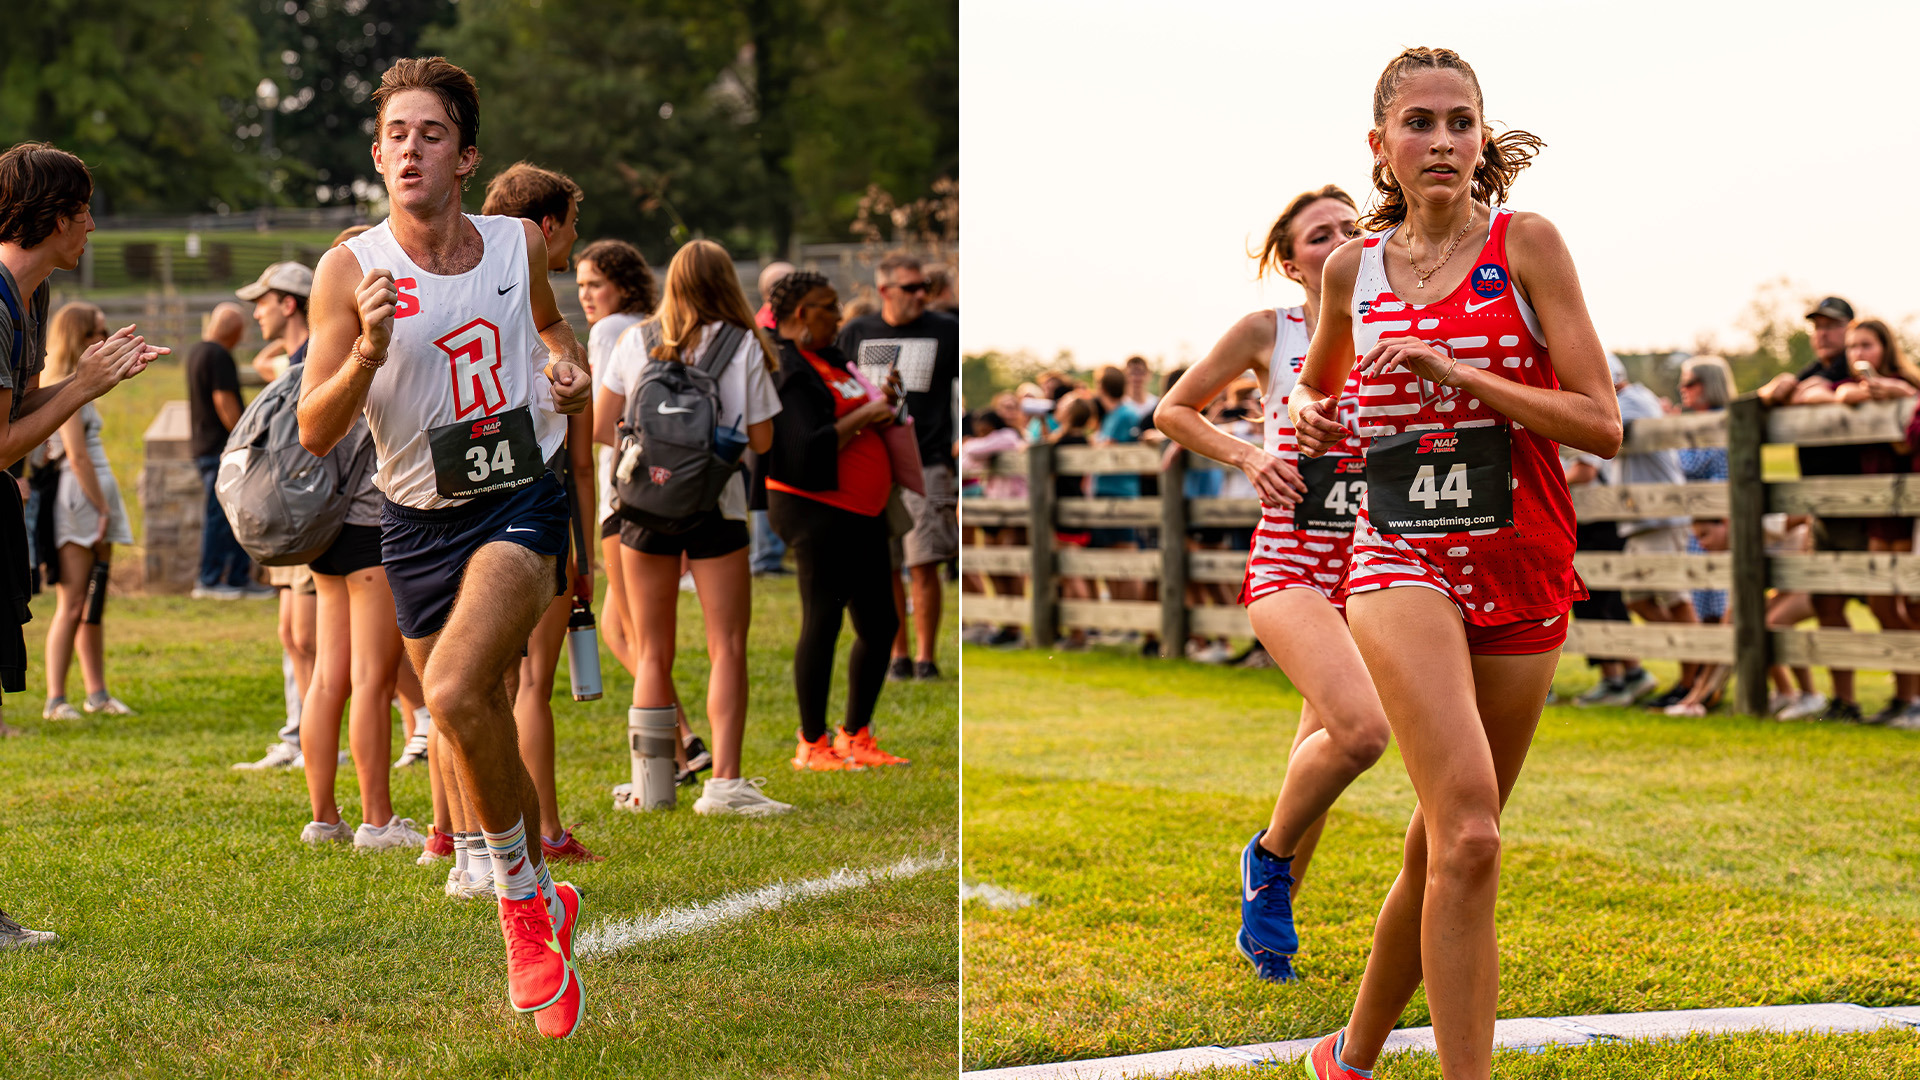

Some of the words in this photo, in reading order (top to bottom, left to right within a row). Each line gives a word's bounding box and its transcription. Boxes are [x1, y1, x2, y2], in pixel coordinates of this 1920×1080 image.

[1480, 268, 1500, 280] VA
[1476, 280, 1505, 291] 250
[431, 316, 508, 421] R
[470, 416, 501, 439] SNAP
[1415, 432, 1459, 454] SNAP
[465, 440, 515, 482] 34
[452, 476, 534, 497] www.snaptiming.com
[1408, 463, 1472, 509] 44
[1324, 480, 1368, 515] 43
[1388, 515, 1495, 528] www.snaptiming.com
